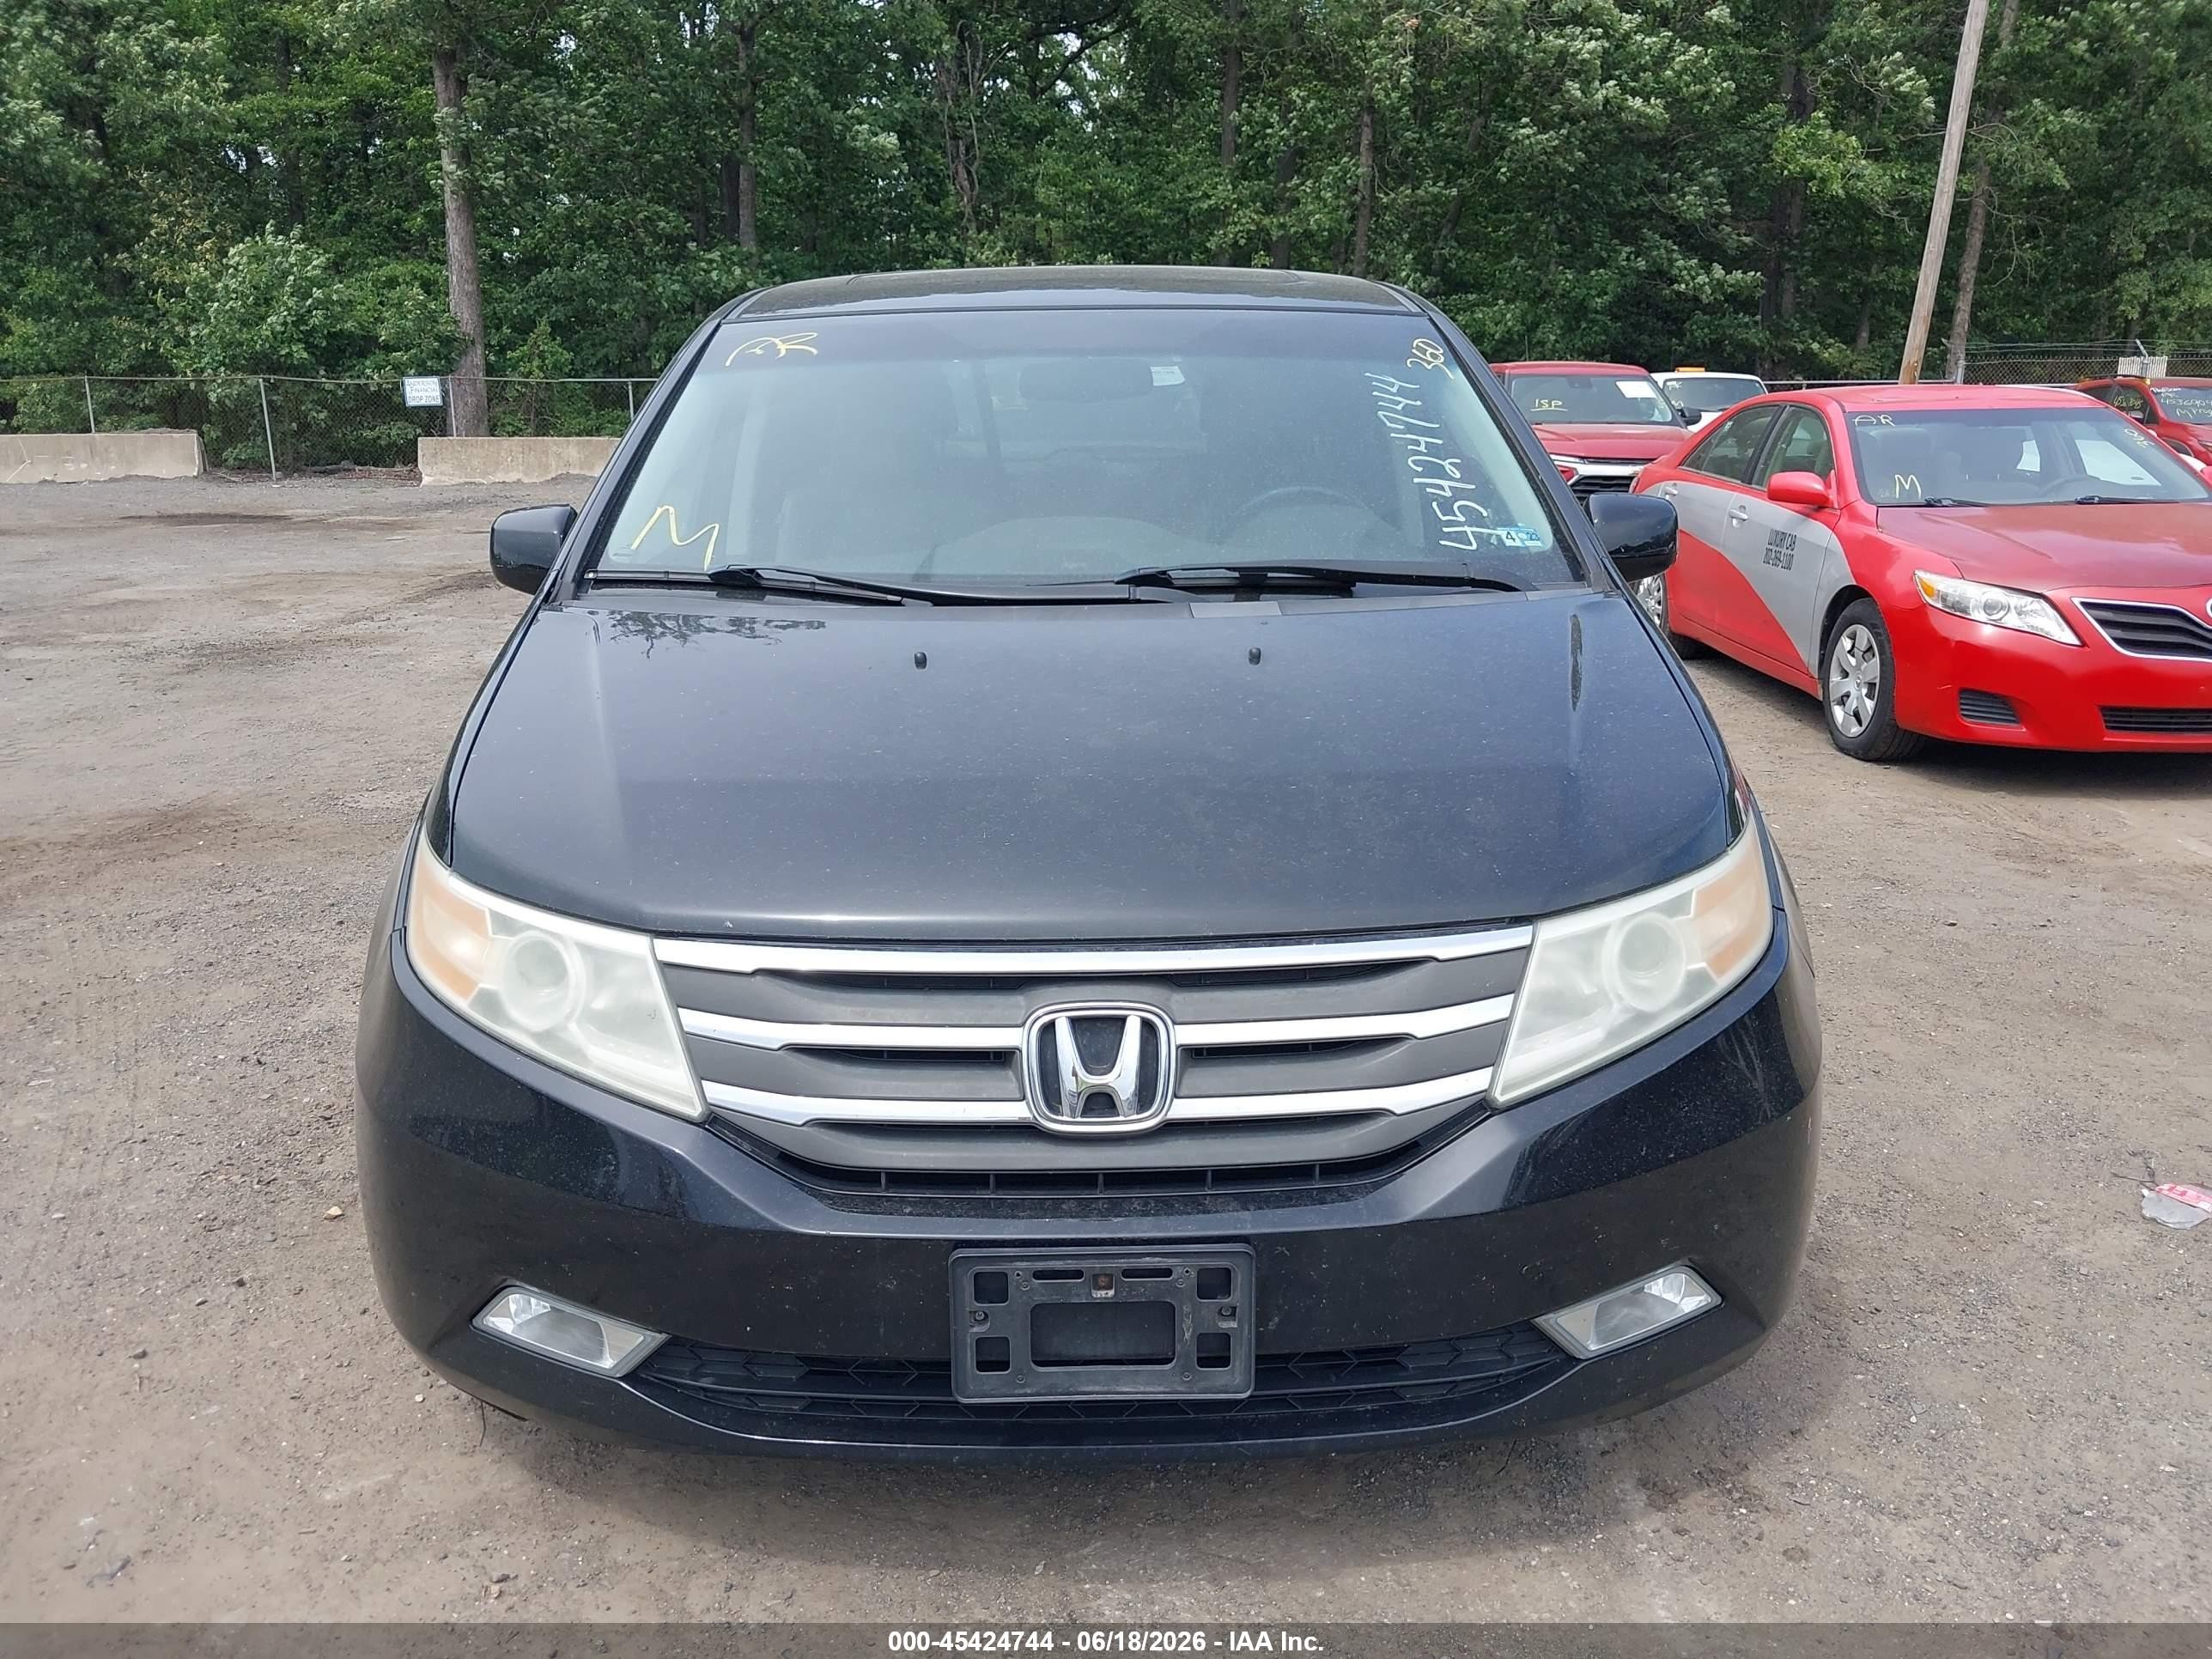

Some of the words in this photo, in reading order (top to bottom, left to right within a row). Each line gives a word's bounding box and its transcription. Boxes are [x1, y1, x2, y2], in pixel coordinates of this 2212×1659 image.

[408, 395, 424, 404] DROP
[424, 395, 440, 404] ZONE
[1852, 414, 1896, 427] AR
[1364, 372, 1506, 550] 45424744
[1894, 474, 1922, 500] M
[629, 505, 720, 571] M
[1767, 529, 1788, 549] LUXURY
[1785, 532, 1797, 551] CAB
